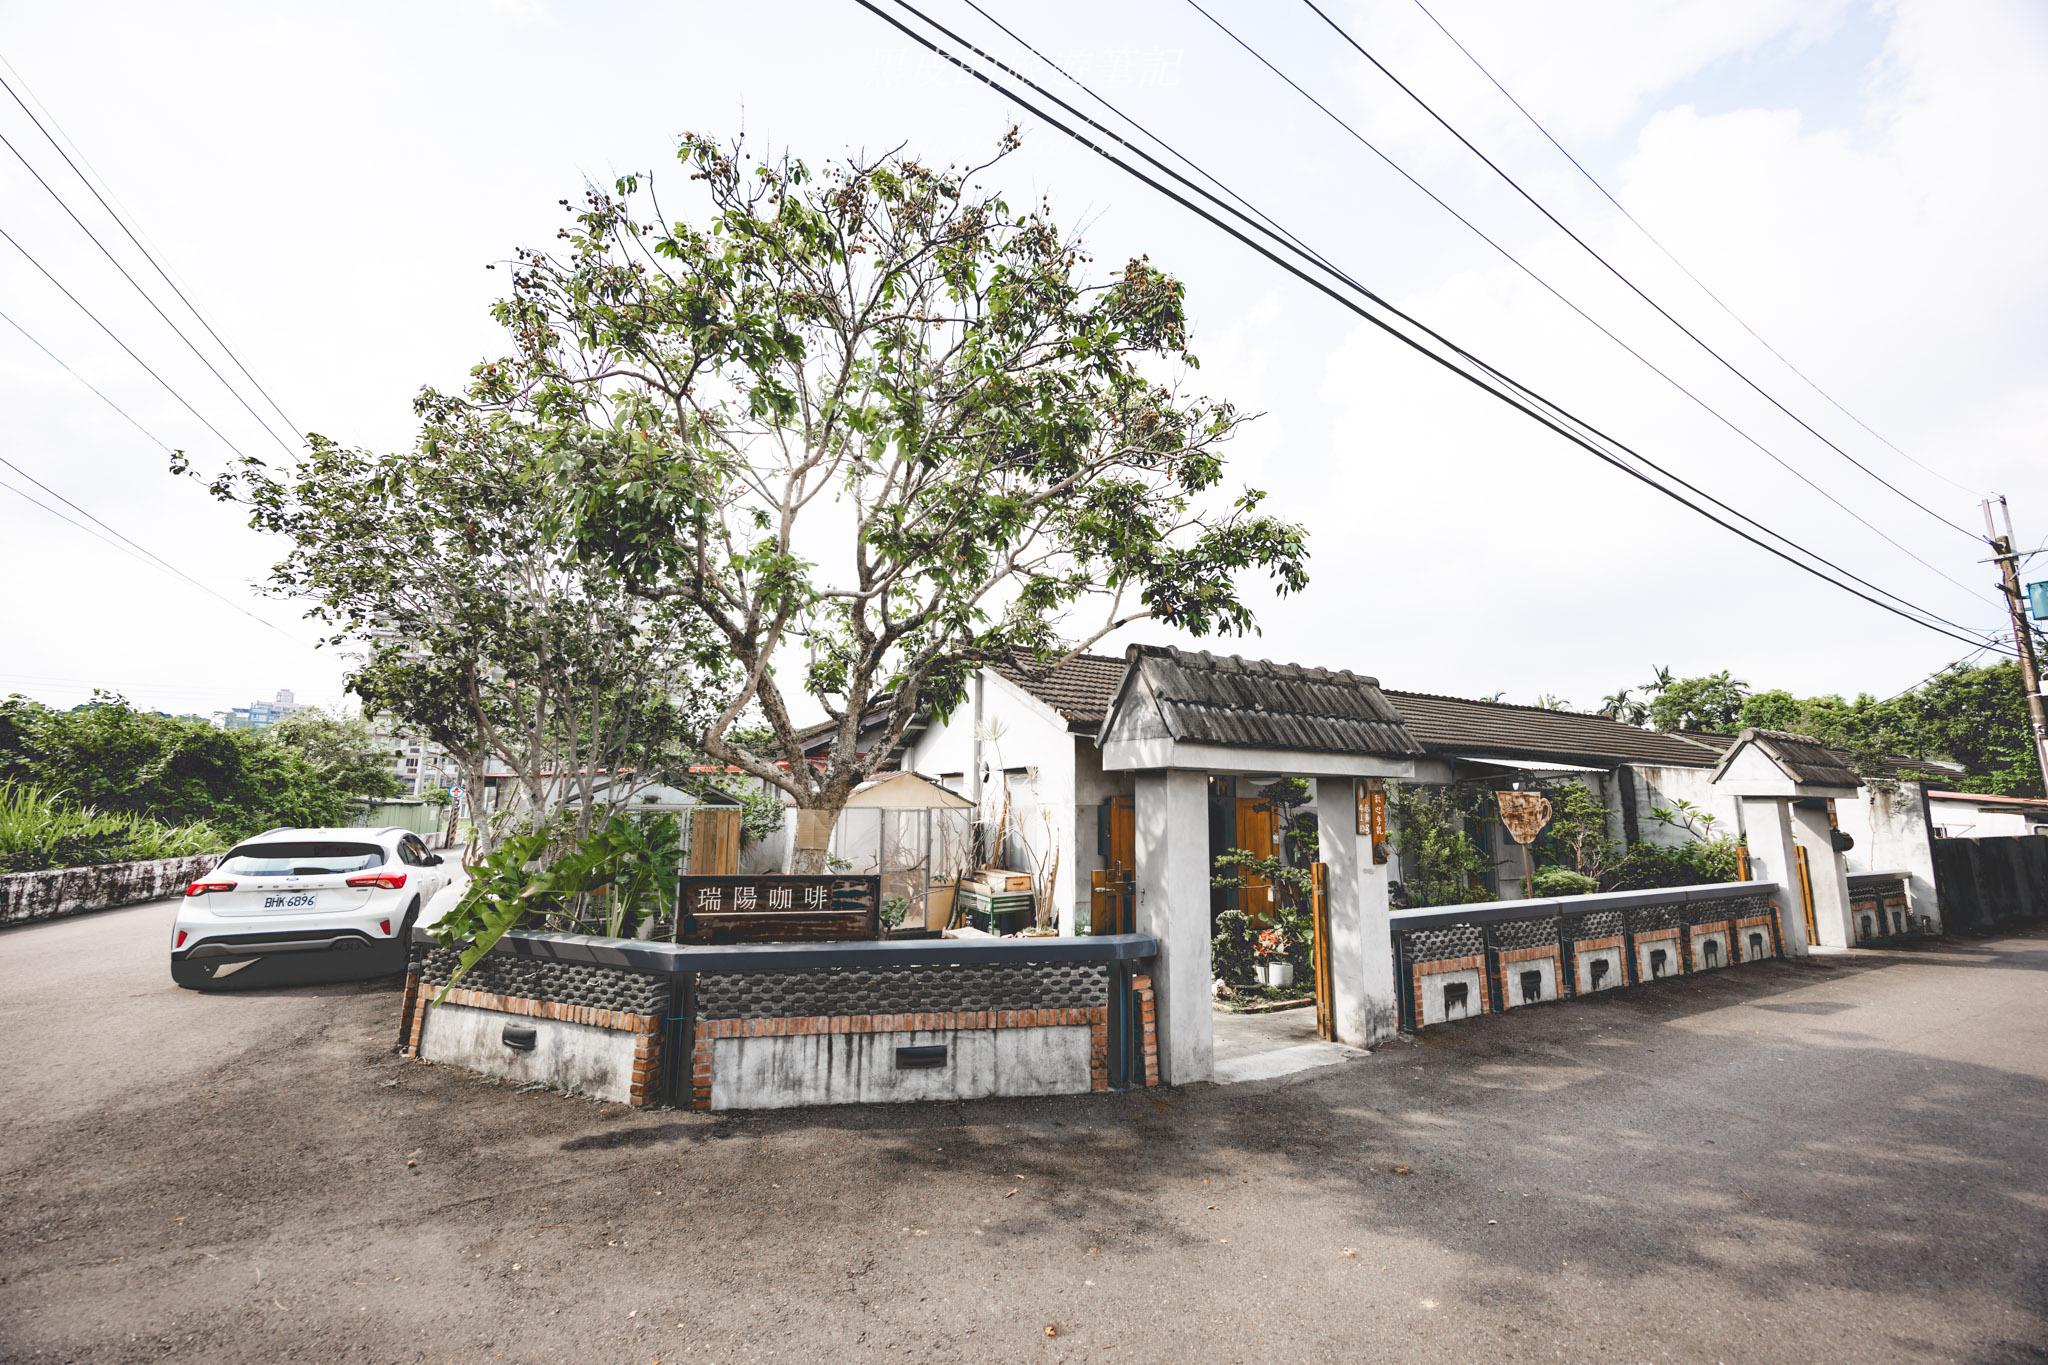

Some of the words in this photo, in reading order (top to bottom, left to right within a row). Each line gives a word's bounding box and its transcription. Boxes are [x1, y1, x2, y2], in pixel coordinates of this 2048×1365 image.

[264, 895, 316, 908] BHK-6896
[697, 886, 828, 911] 瑞陽咖啡
